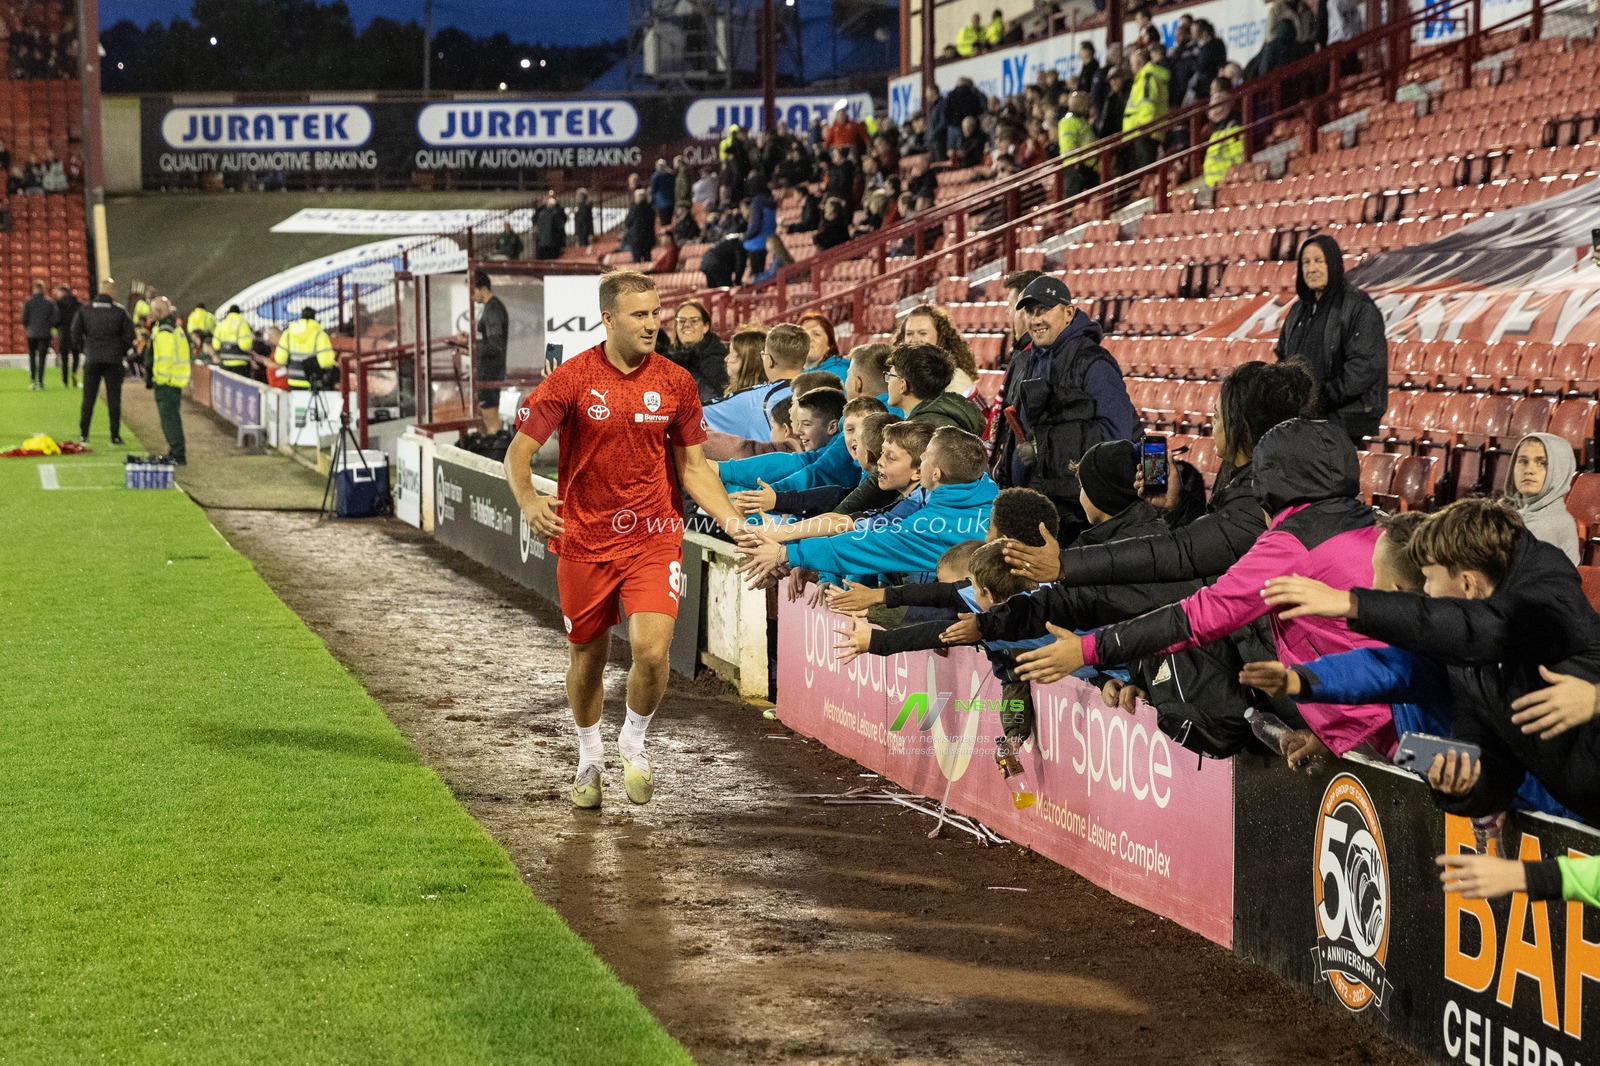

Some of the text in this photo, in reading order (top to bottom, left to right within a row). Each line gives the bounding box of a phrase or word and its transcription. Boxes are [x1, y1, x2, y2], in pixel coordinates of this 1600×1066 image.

[182, 113, 350, 143] JURATEK
[440, 108, 616, 139] JURATEK
[159, 150, 378, 172] QUALITY AUTOMOTIVE BRAKING
[415, 146, 642, 169] QUALITY AUTOMOTIVE BRAKING
[823, 696, 857, 731] Metrodome
[857, 713, 878, 743] Leisure
[1071, 700, 1172, 808] space
[1036, 790, 1171, 879] Metrodome Leisure Complex
[1327, 946, 1376, 983] ANNIVERSARY
[1352, 986, 1366, 1003] 2022
